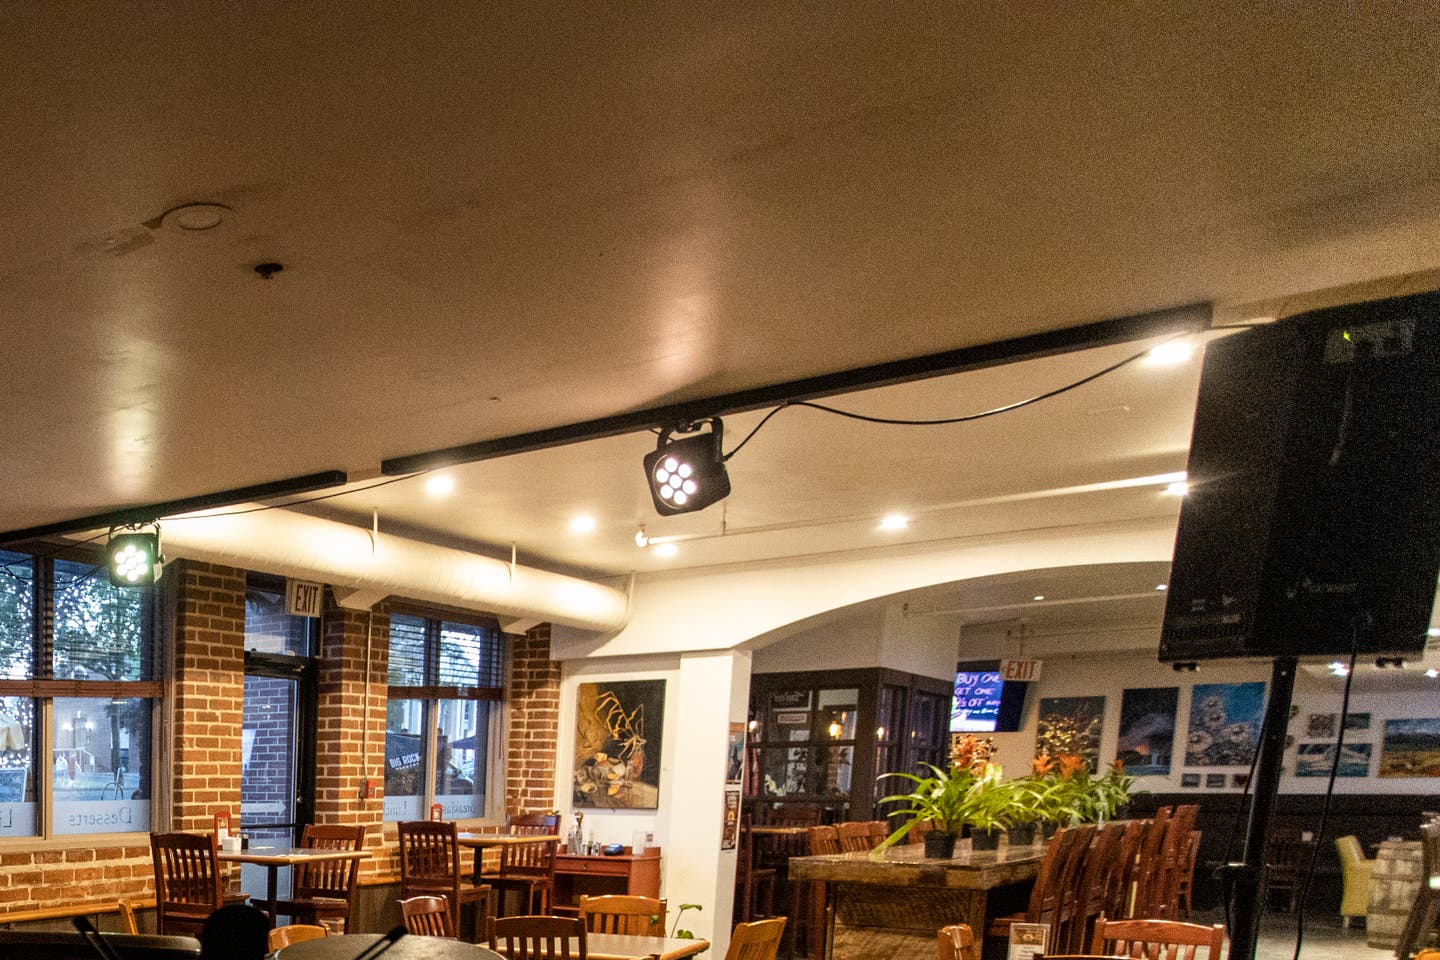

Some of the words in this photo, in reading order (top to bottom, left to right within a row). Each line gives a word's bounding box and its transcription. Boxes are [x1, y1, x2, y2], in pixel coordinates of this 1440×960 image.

[295, 584, 319, 614] EXIT
[1005, 660, 1036, 680] EXIT
[957, 673, 979, 687] BUY
[954, 687, 971, 696] GET
[974, 687, 996, 696] ONE
[389, 757, 401, 768] BIG
[402, 753, 420, 765] ROCK
